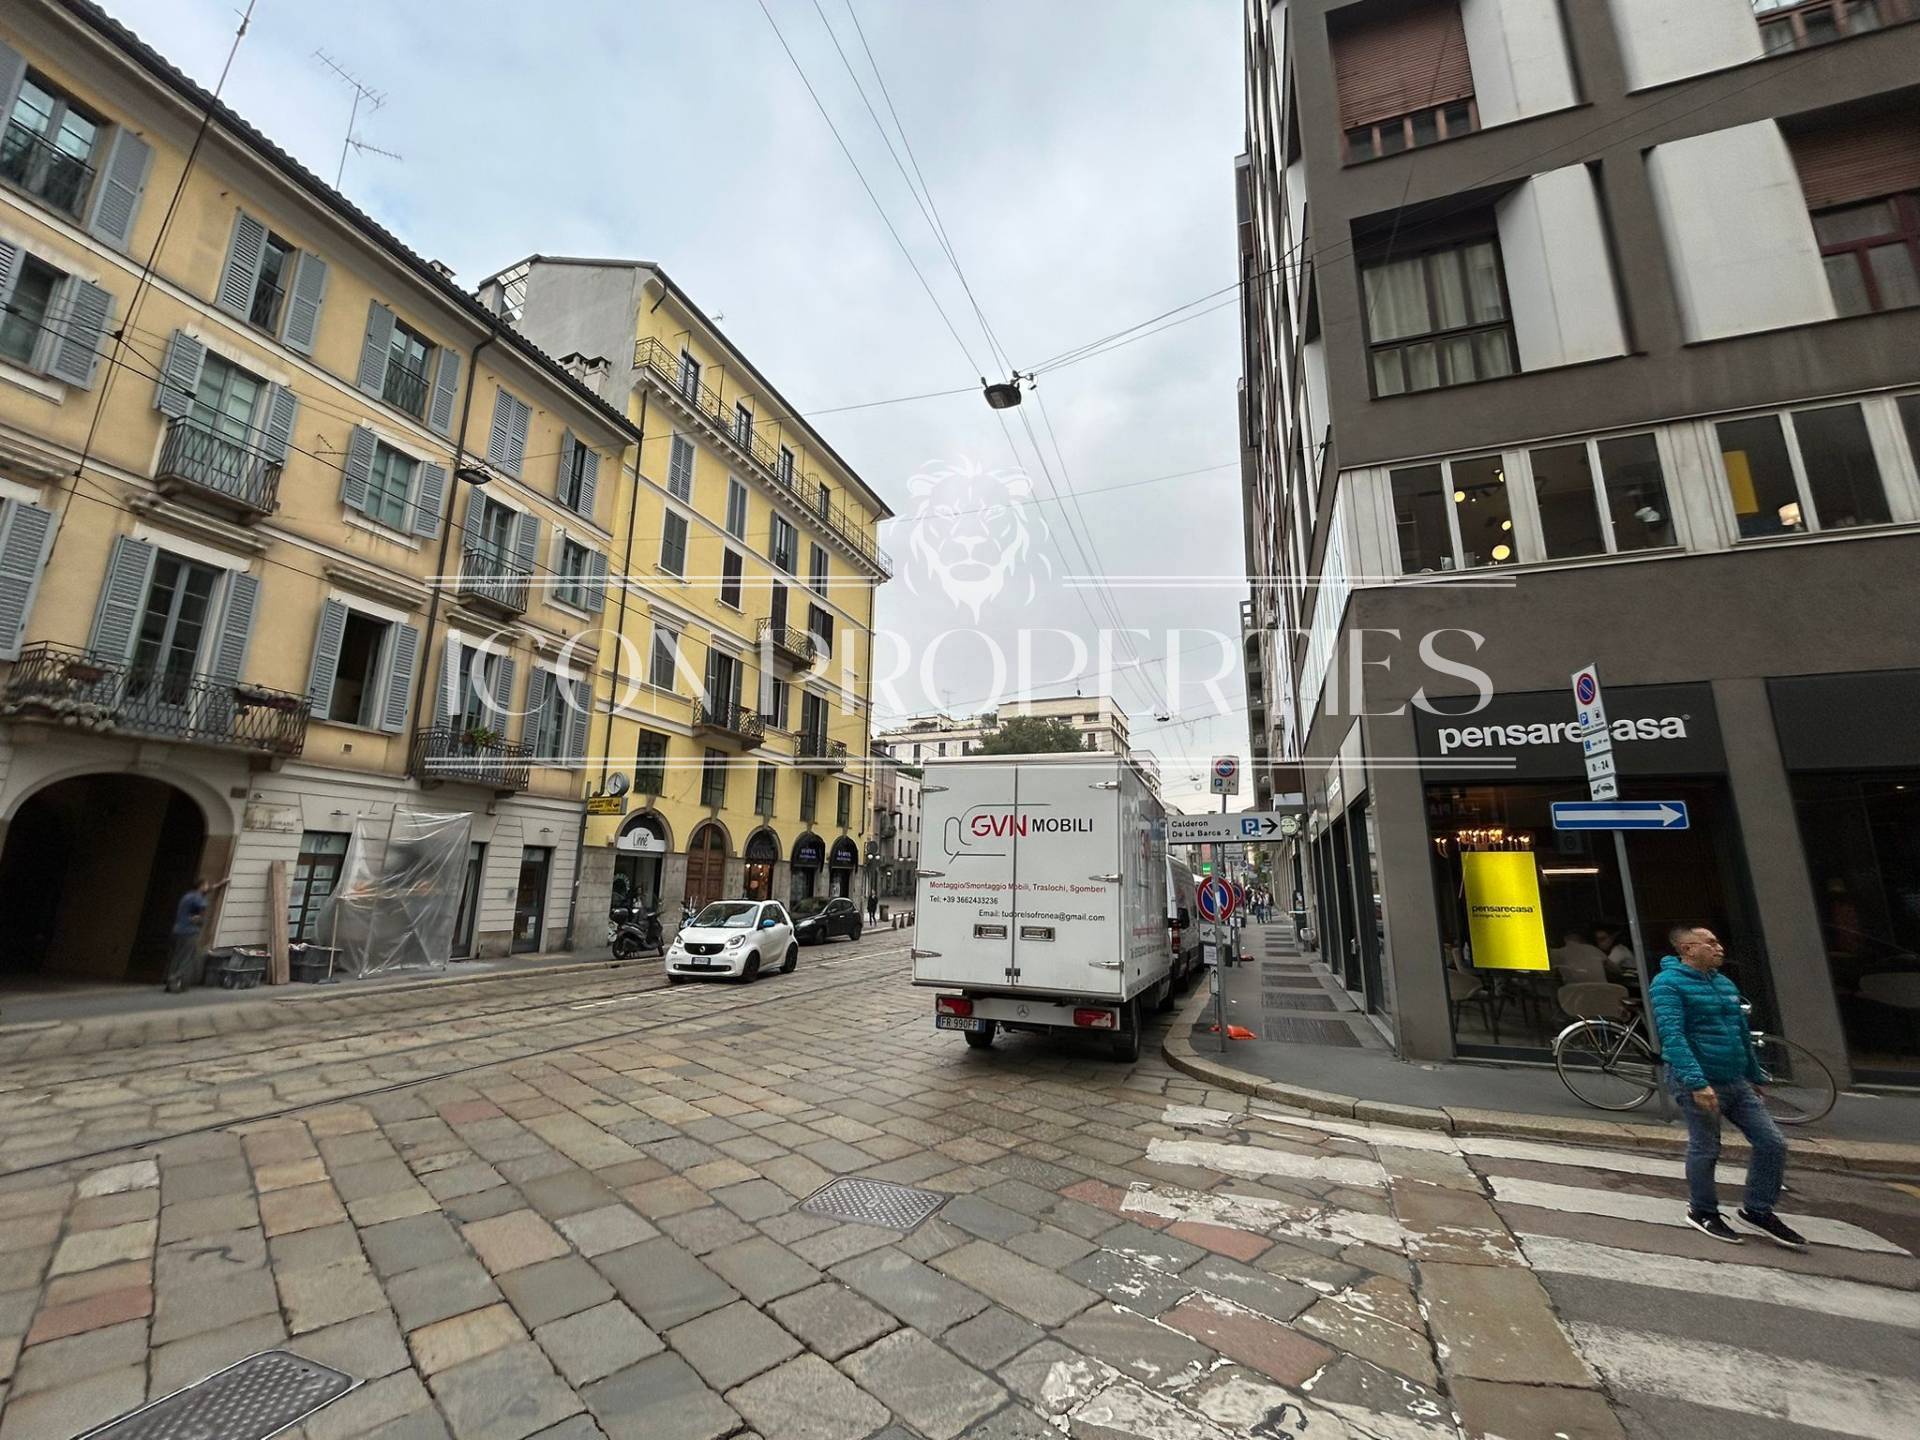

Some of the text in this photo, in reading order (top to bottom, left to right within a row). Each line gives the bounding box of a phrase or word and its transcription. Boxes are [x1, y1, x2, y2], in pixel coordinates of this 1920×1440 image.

[1437, 716, 1688, 755] pensareasa
[971, 814, 1093, 837] GVN MOBILI
[1171, 820, 1209, 828] Calderon
[1171, 830, 1183, 838] De
[1197, 829, 1221, 837] Barca
[1224, 828, 1231, 836] 2
[929, 881, 1007, 891] Montaggio/Smontaggio
[1033, 883, 1068, 893] Traslochi,
[1069, 884, 1106, 894] Sgomberi
[943, 896, 955, 904] +39
